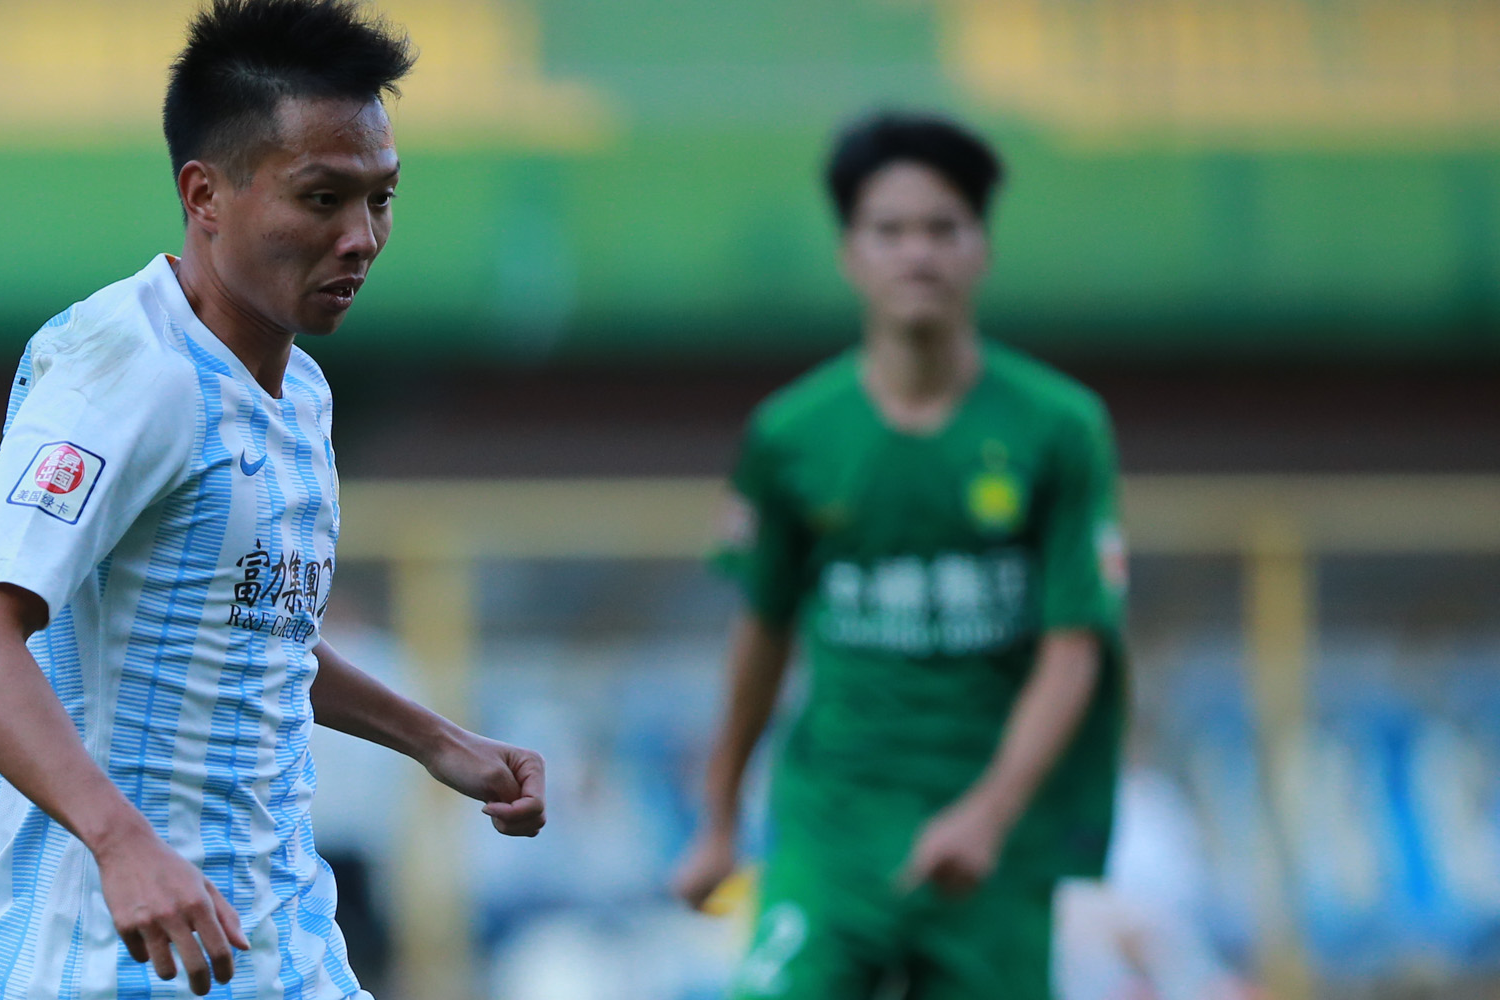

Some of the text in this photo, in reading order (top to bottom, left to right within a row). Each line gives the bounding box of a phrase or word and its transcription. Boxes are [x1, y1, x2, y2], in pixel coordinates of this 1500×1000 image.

[15, 489, 69, 514] 美国绿卡
[270, 615, 316, 645] GROUP
